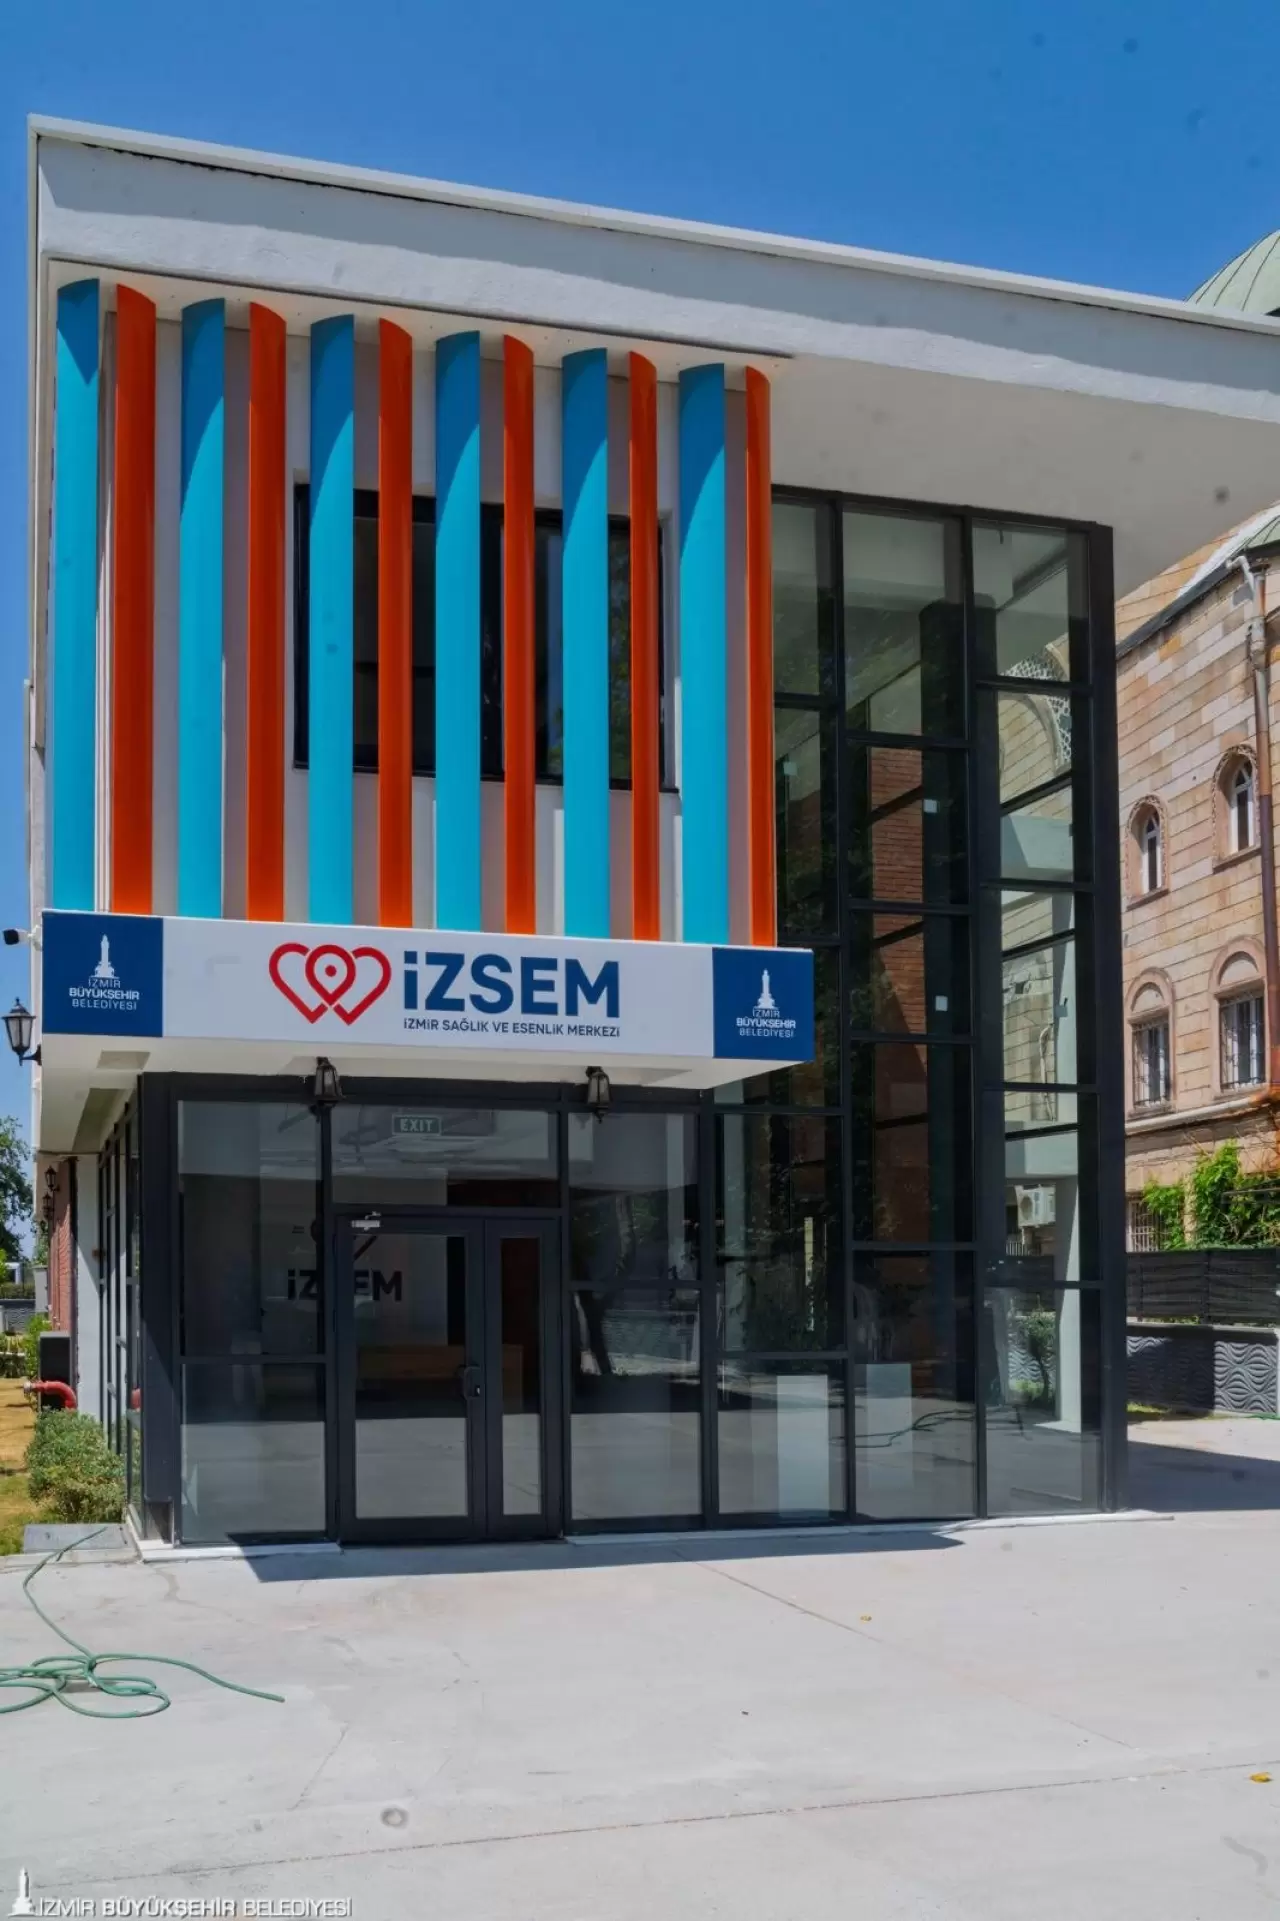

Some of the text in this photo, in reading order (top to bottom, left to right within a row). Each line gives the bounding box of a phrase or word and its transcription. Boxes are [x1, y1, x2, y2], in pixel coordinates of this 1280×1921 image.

[442, 1017, 489, 1033] SAĞLIK
[492, 1021, 509, 1033] VE
[400, 1118, 433, 1132] EXIT
